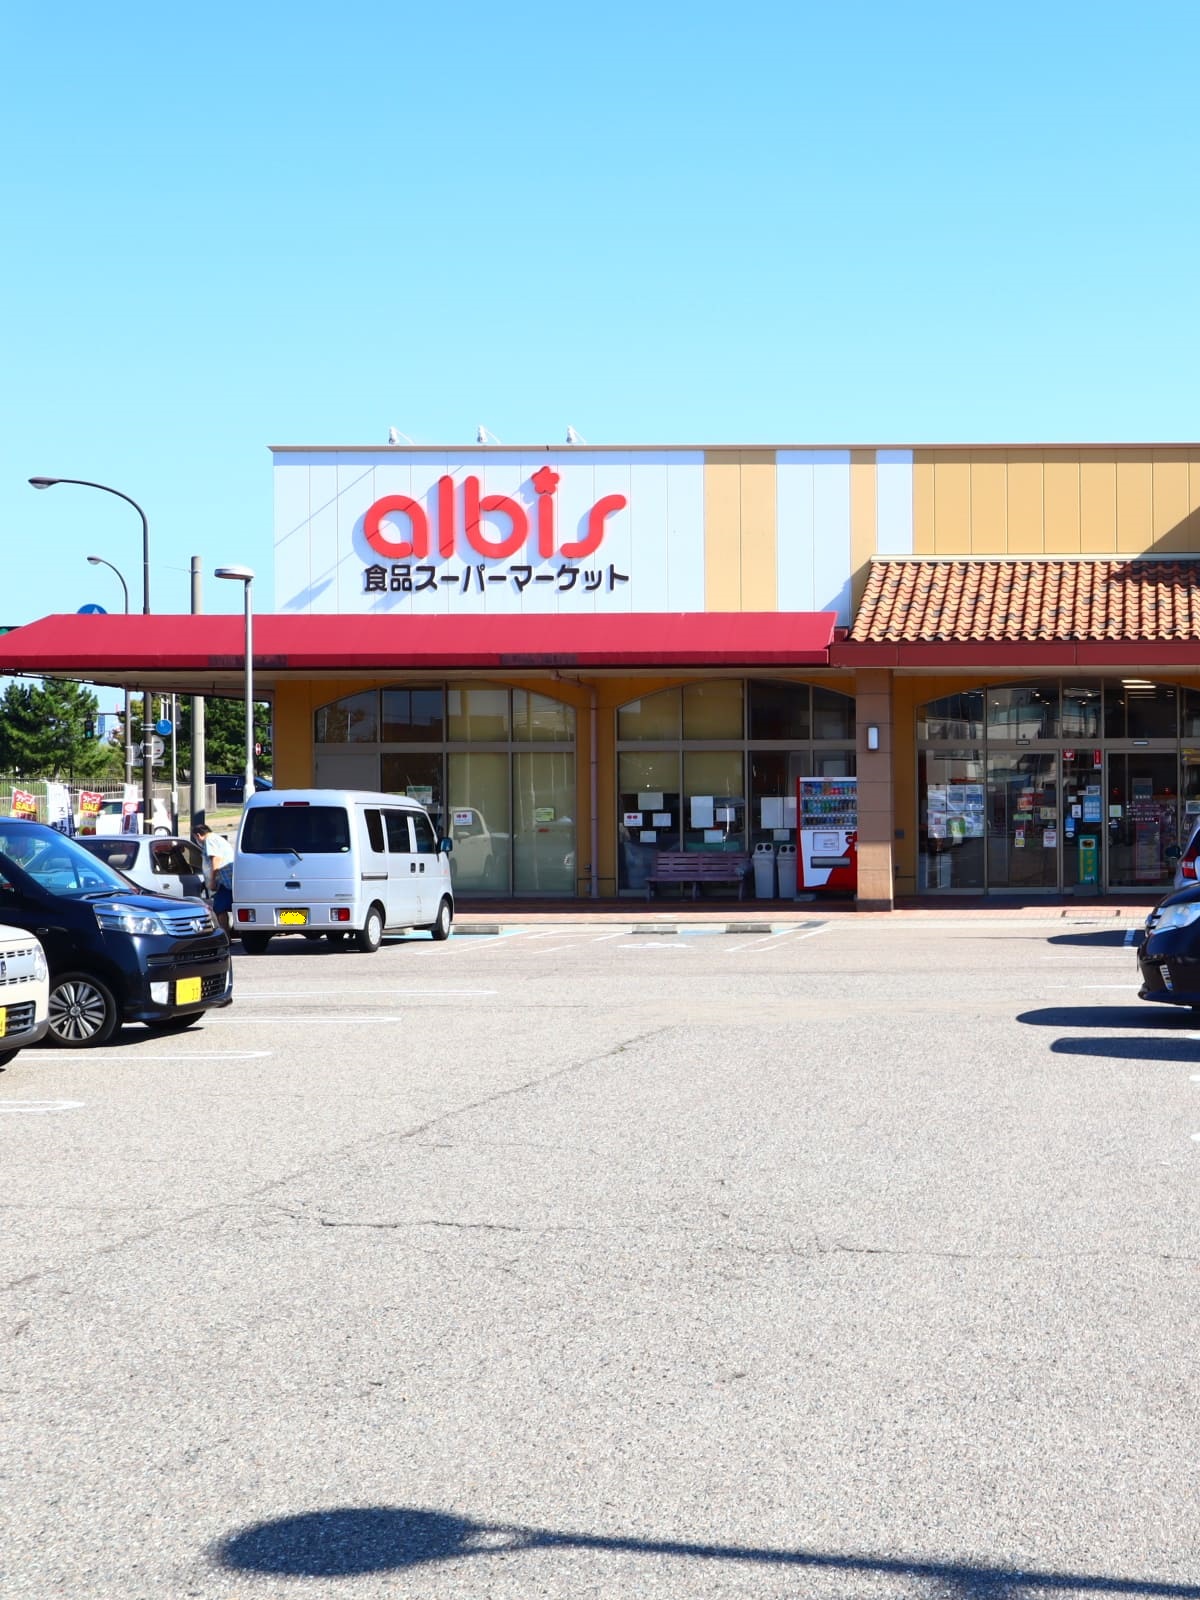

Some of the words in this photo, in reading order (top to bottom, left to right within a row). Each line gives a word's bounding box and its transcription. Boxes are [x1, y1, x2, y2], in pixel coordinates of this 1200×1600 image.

[364, 466, 627, 559] albis
[364, 564, 629, 593] 食品スーパーマーケット
[15, 801, 36, 812] SALE
[82, 802, 99, 811] SALE
